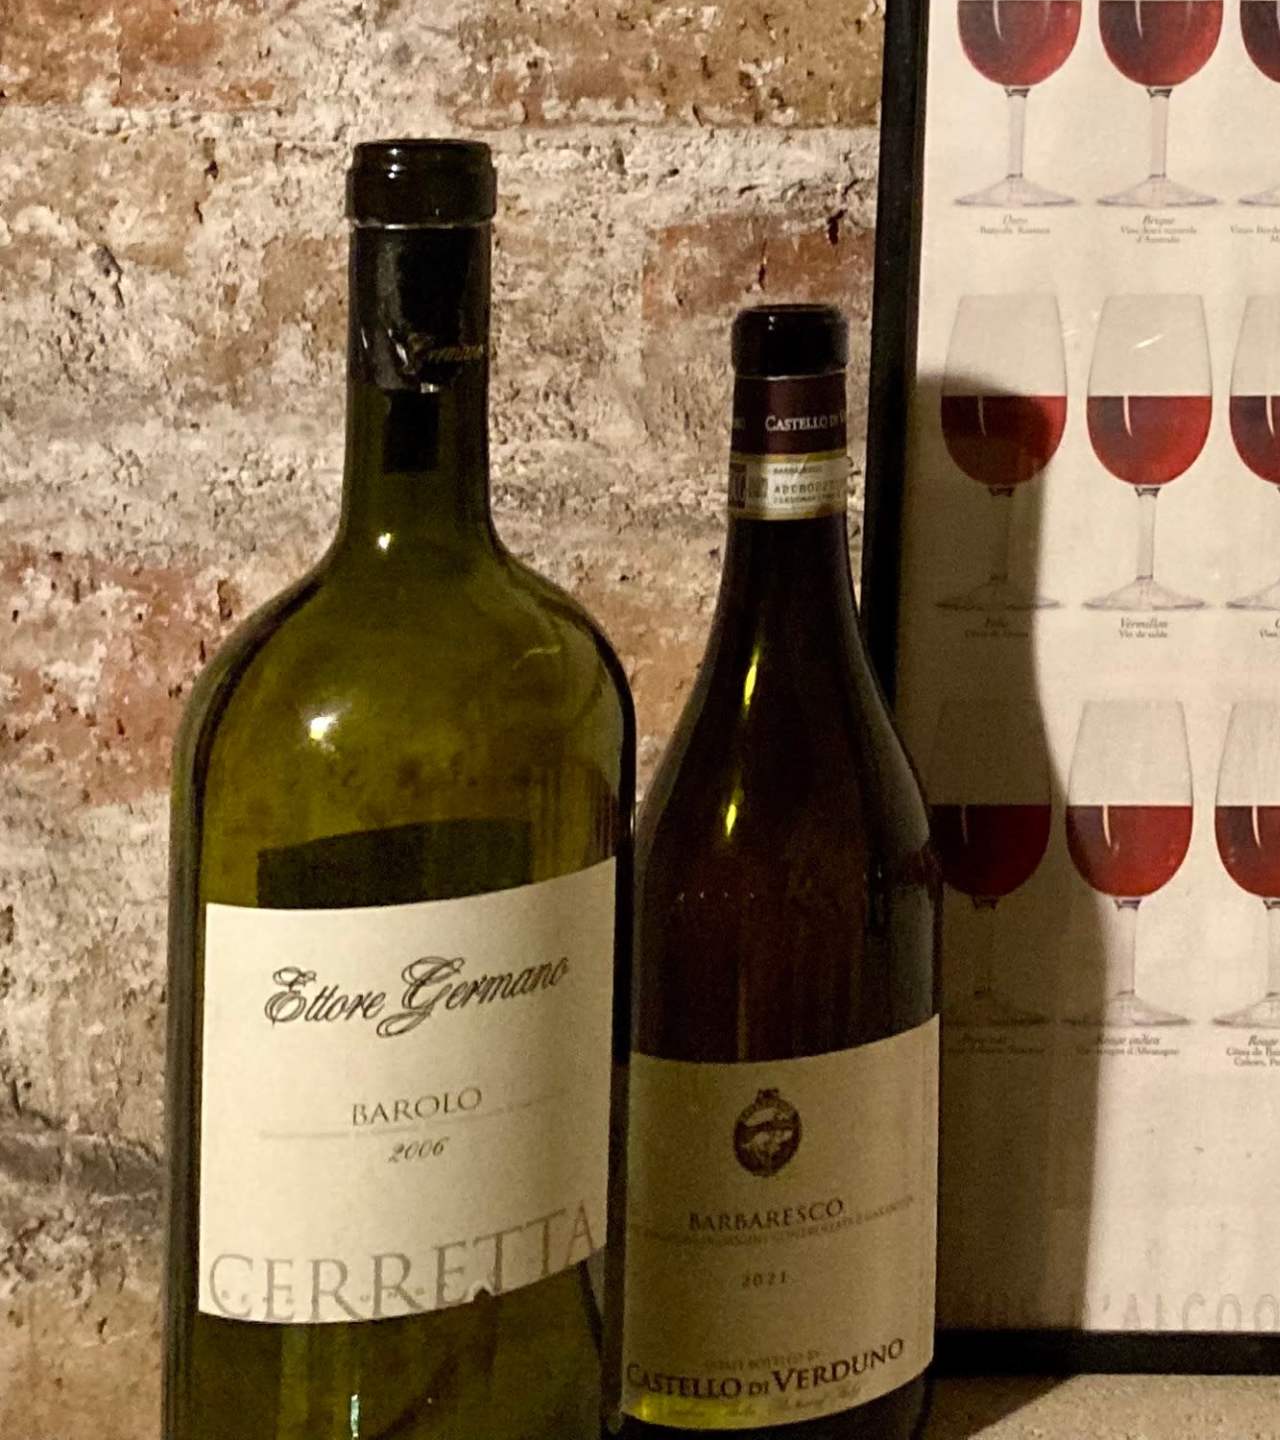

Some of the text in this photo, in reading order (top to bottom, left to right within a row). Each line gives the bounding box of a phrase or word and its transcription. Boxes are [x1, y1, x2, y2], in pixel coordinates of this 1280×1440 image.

[765, 414, 828, 432] CASTELLO
[264, 955, 570, 1038] Ettore Germano
[351, 1086, 484, 1128] BAROLO
[387, 1136, 451, 1164] 2006
[687, 1196, 844, 1233] BARBARESCO
[208, 1204, 597, 1324] CERRETTA
[626, 1362, 743, 1399] CASTELLO
[771, 1336, 906, 1393] VERDUNO
